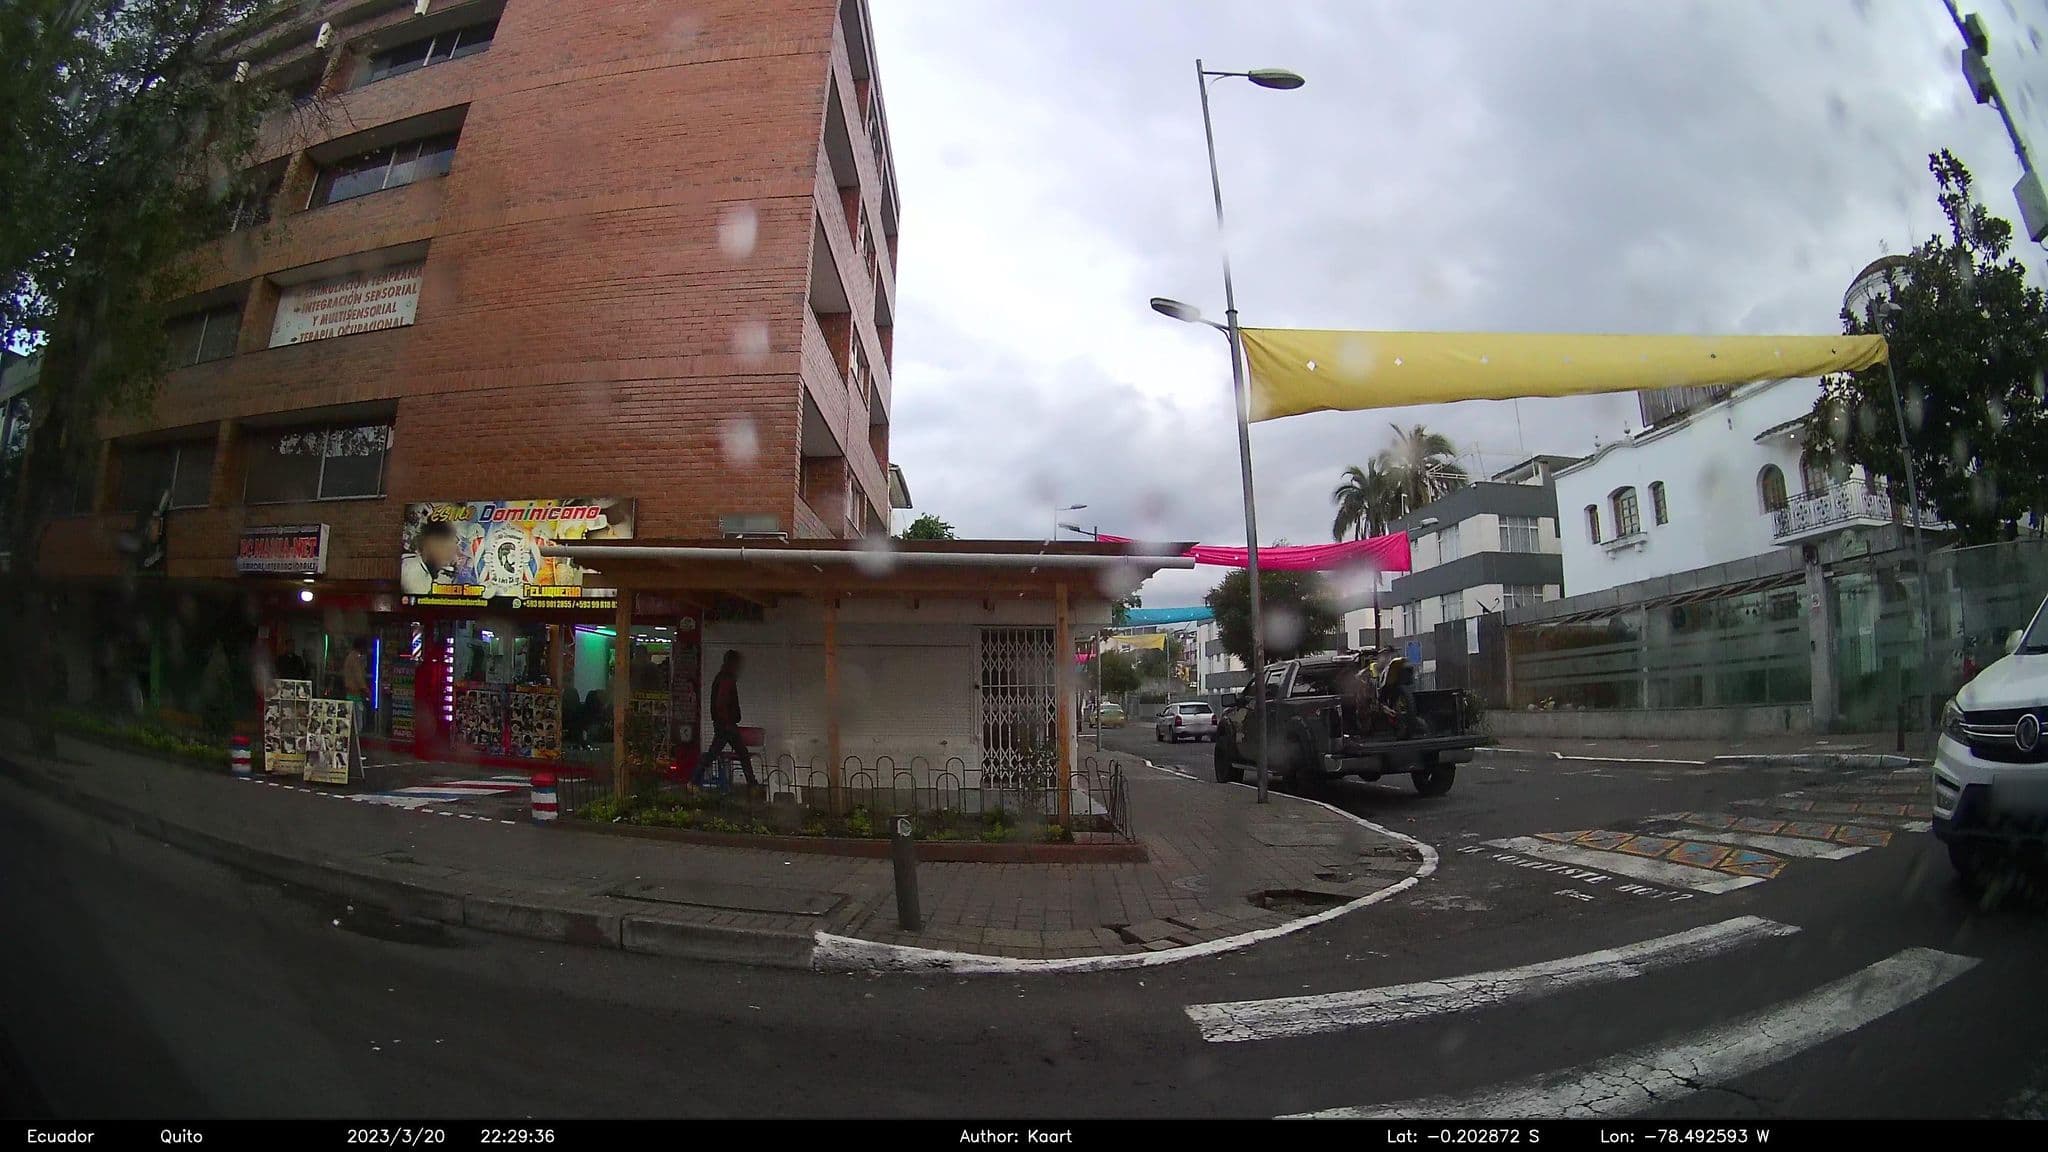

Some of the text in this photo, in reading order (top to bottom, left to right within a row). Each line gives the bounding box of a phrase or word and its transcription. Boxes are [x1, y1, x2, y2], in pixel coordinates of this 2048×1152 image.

[301, 284, 418, 314] INTEGRACIÓN SENSORIAL
[312, 302, 397, 327] Y MULTISENSORIAL
[299, 316, 406, 343] TERAPIA OCUPACIONAL
[479, 501, 602, 523] Dominicano
